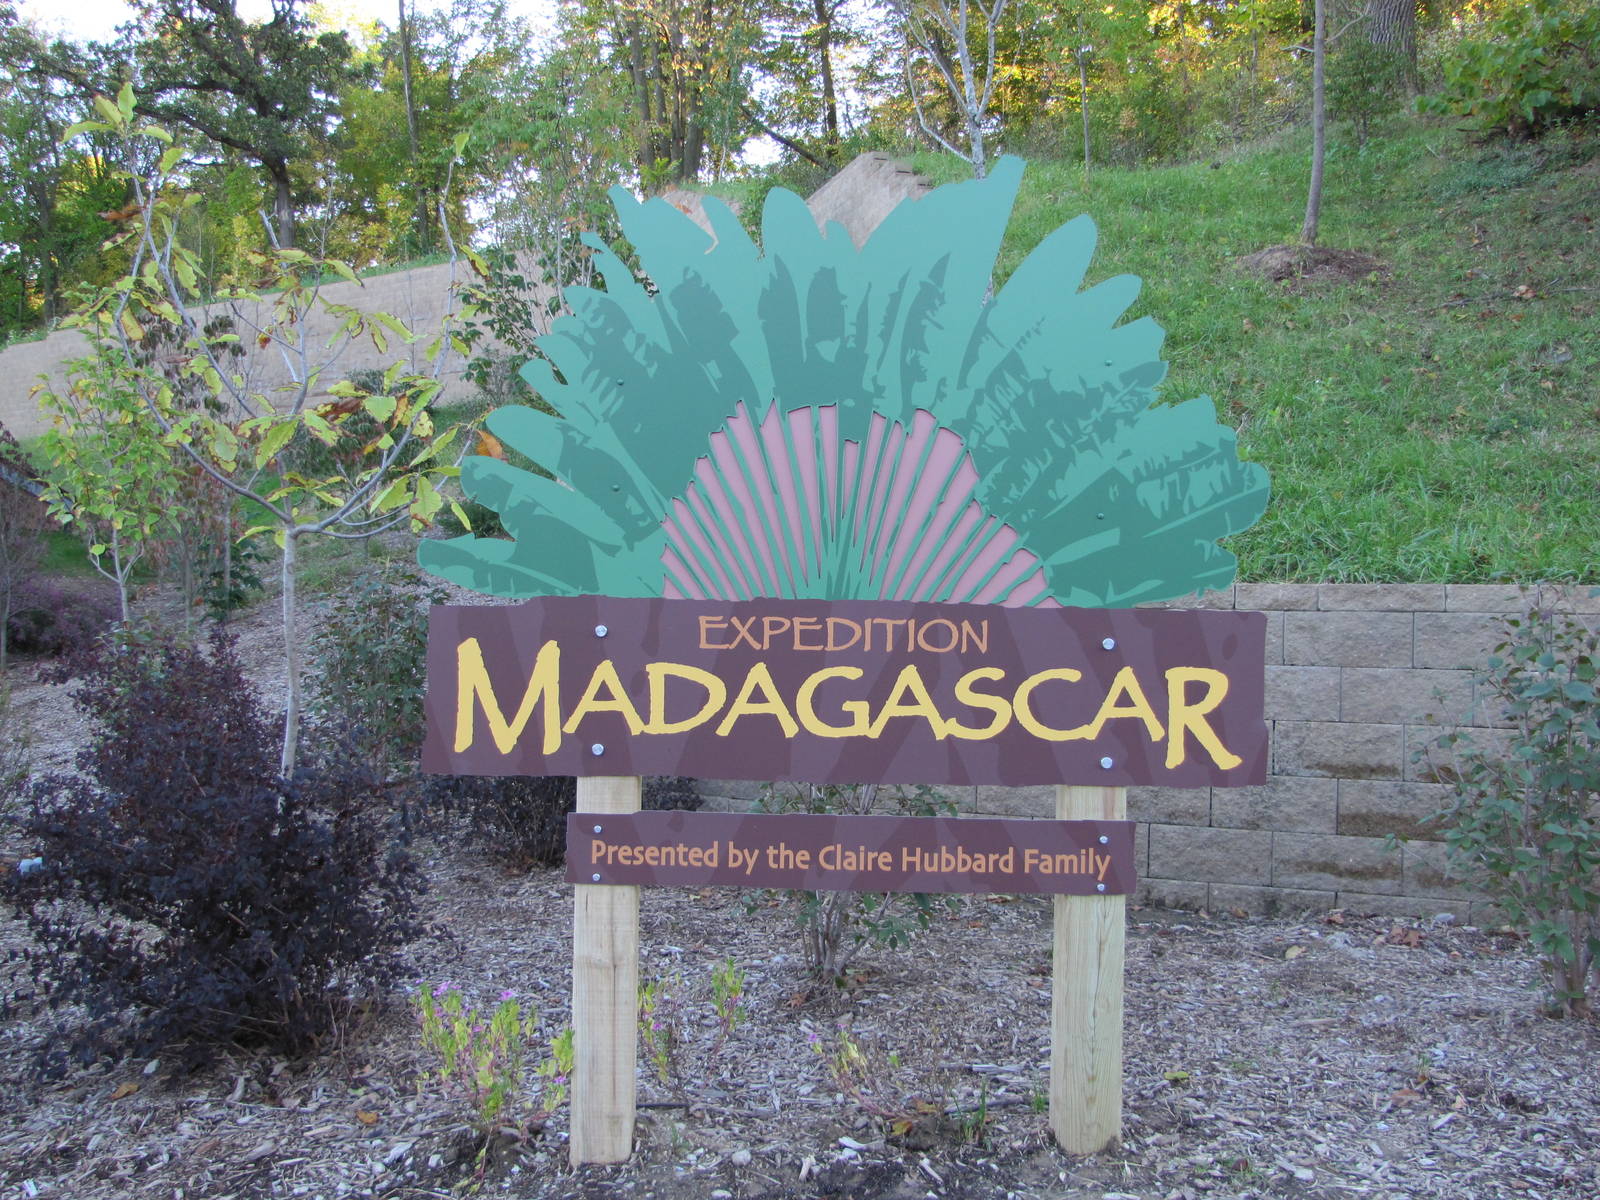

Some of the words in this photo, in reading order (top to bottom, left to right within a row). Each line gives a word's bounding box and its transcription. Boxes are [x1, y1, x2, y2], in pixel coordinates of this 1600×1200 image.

[698, 614, 990, 654] EXPEDITION
[453, 637, 1243, 771] MADAGASCAR
[591, 838, 719, 868] Presented
[727, 841, 760, 876] by
[767, 842, 811, 870] the
[818, 843, 893, 872] Claire
[901, 845, 1016, 874] Hubbard
[1024, 846, 1112, 880] Family
